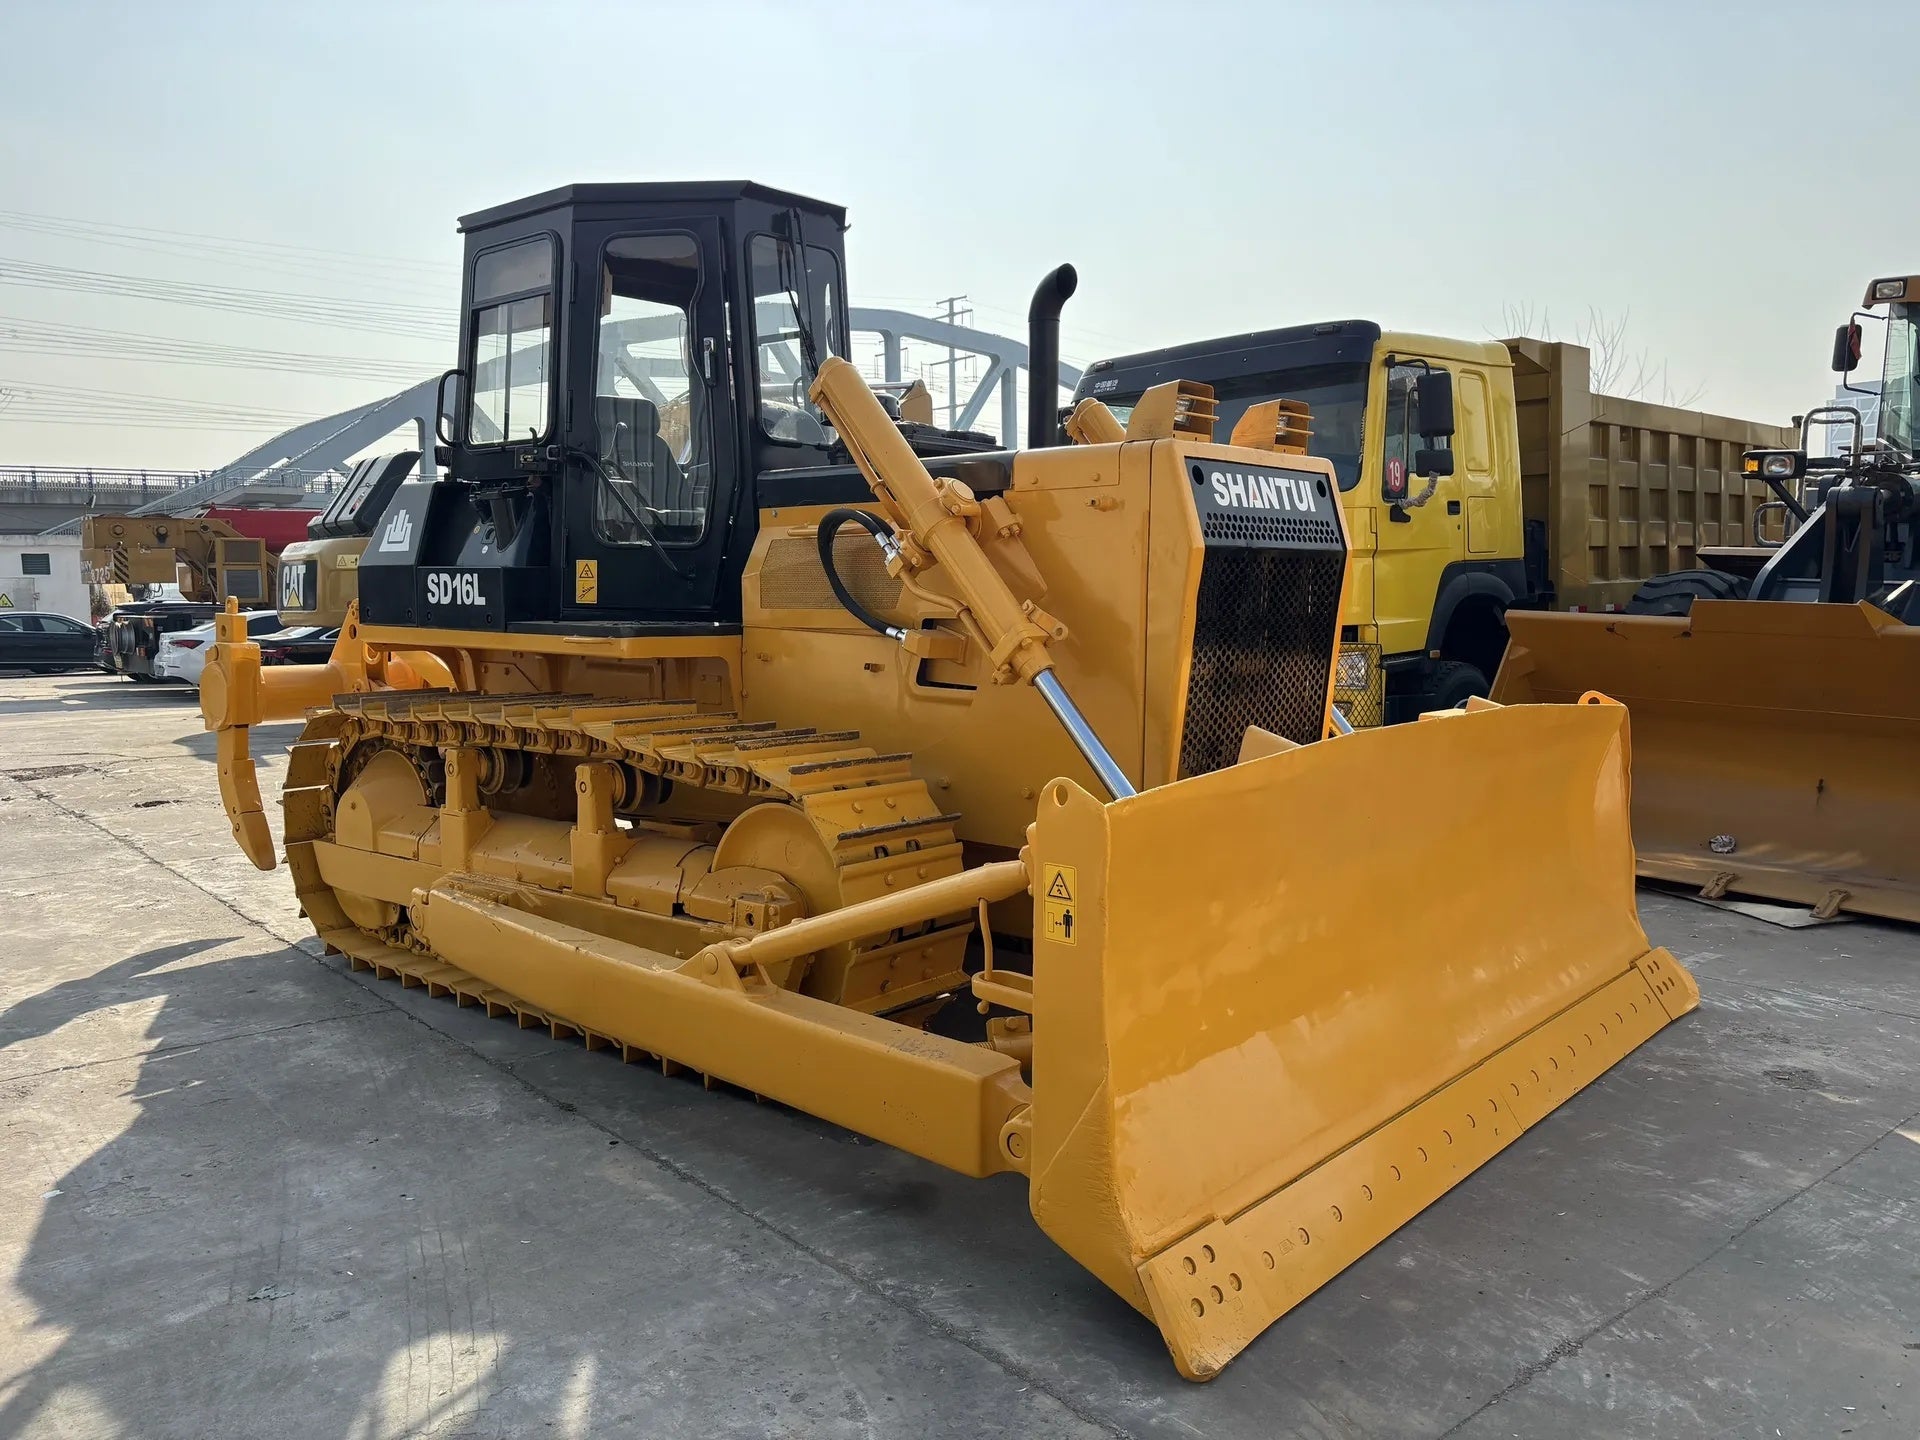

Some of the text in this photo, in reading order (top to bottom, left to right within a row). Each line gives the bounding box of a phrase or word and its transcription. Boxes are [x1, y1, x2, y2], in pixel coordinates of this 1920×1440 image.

[1211, 472, 1316, 512] SHANTUI
[1390, 461, 1400, 487] 19
[282, 564, 306, 607] CAT
[427, 573, 486, 606] SD16L
